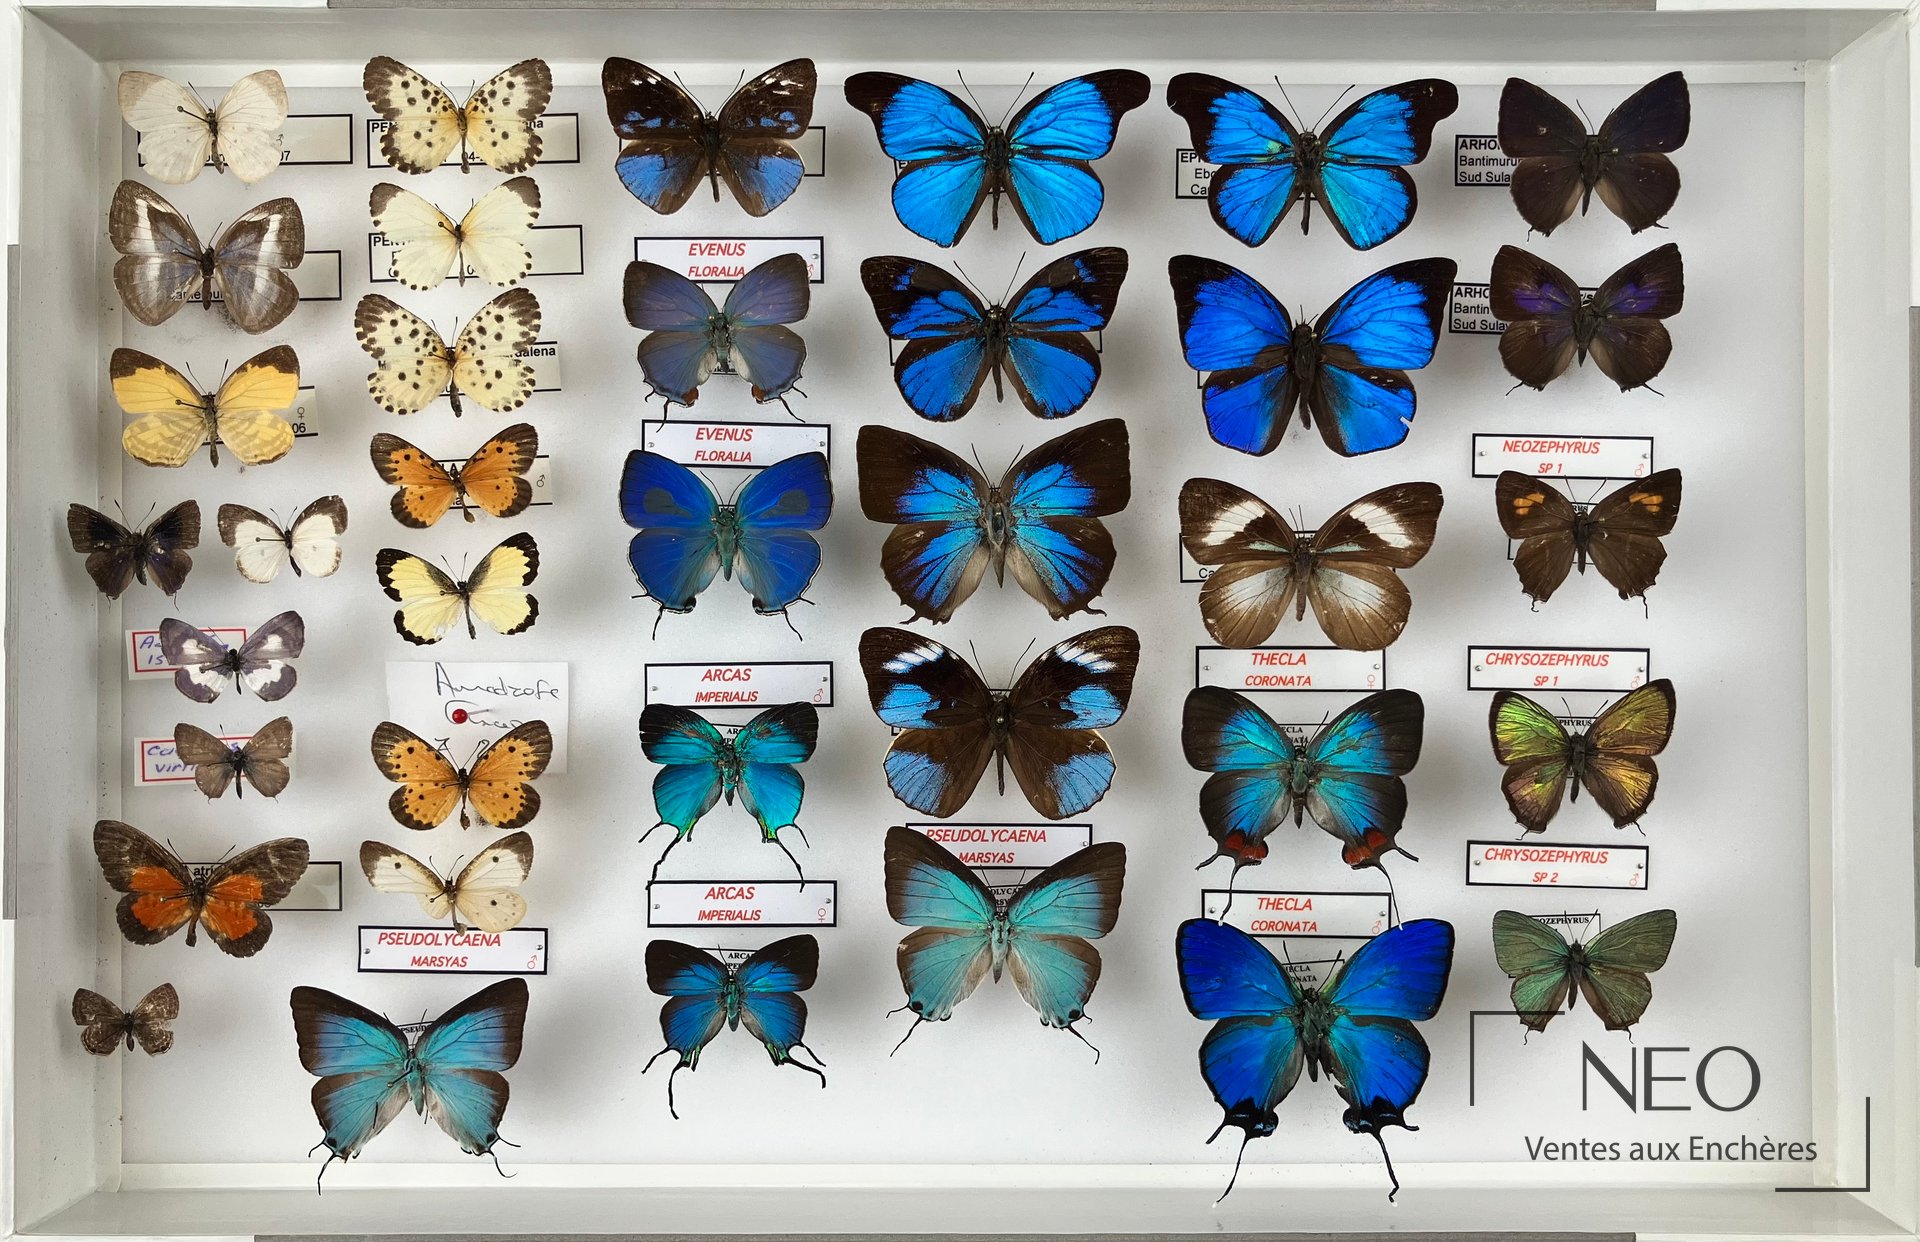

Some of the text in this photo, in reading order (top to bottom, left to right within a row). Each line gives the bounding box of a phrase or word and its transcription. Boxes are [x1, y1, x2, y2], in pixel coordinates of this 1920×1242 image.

[1459, 139, 1499, 150] ARHO
[1459, 171, 1482, 183] Sud
[688, 242, 746, 257] EVENUS
[687, 265, 746, 277] FLORALIA
[1453, 319, 1476, 331] Sud
[695, 427, 753, 442] EVENUS
[1502, 439, 1601, 454] NEOZEPHYRUS
[694, 450, 752, 462] FLORALIA
[1537, 463, 1563, 474] SP 1
[1251, 652, 1307, 666] THECLA
[1485, 652, 1610, 667] CHRYSOZEPHYRUS
[701, 668, 752, 682] ARCAS
[1245, 675, 1312, 687] CORONATA
[1533, 675, 1559, 687] SP 1
[695, 691, 759, 703] IMPERIALIS
[926, 828, 1047, 843] PSEUDOLYCAENA
[959, 852, 1015, 864] MARSYAS
[1484, 847, 1609, 864] CHRYSOZEPHYRUS
[1532, 872, 1559, 883] SP 2
[704, 886, 756, 900] ARCAS
[1257, 897, 1313, 911] THECLA
[697, 909, 762, 921] IMPERIALIS
[1250, 920, 1318, 932] CORONATA
[377, 931, 502, 947] PSEUDOLYCAENA
[410, 955, 469, 968] MARSYAS
